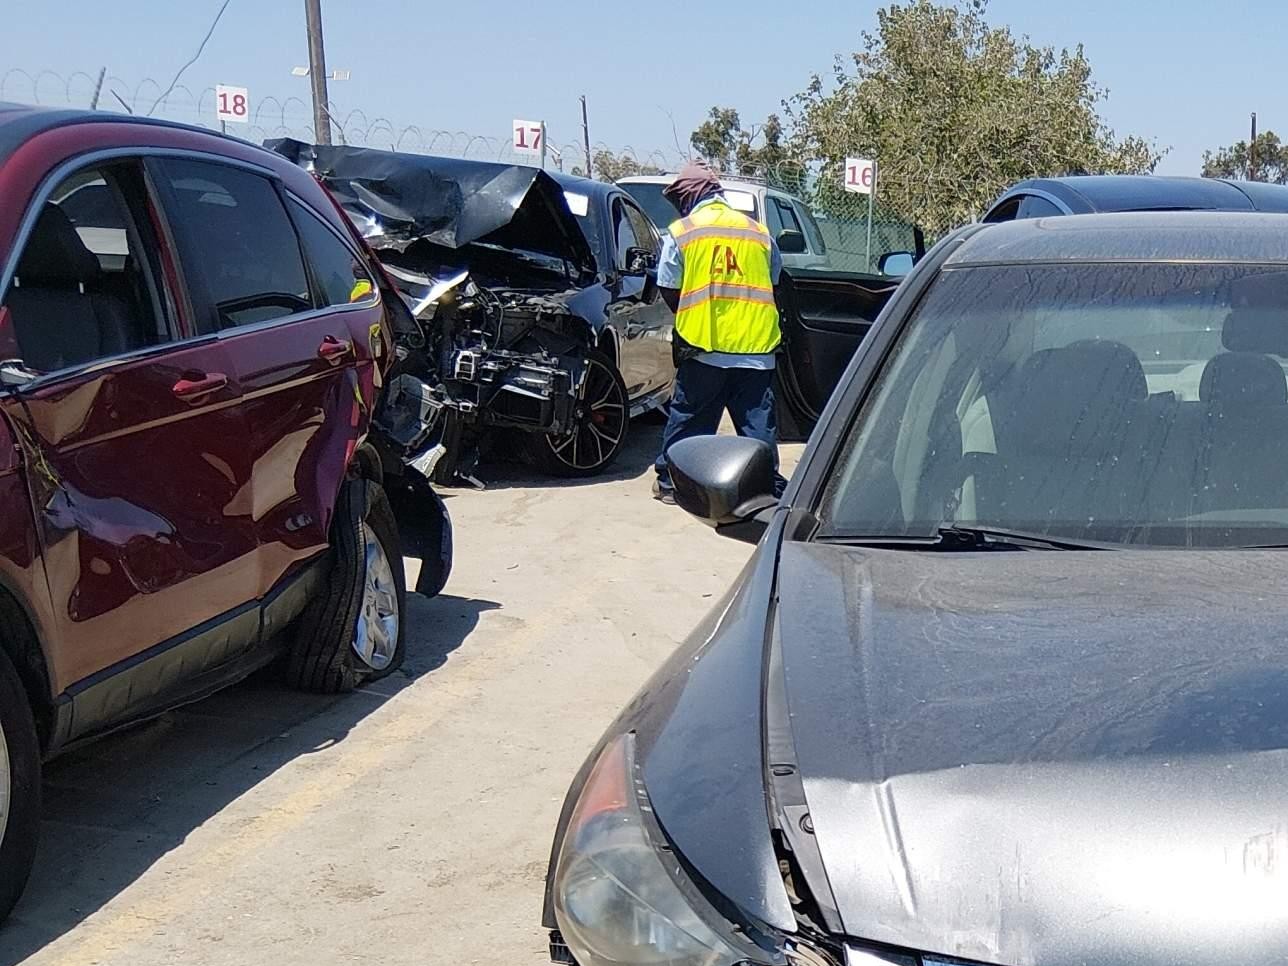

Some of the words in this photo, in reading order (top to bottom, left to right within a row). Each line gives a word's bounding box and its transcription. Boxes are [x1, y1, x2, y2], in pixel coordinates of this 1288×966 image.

[218, 92, 246, 116] 18
[515, 126, 542, 150] 17
[847, 165, 873, 188] 16
